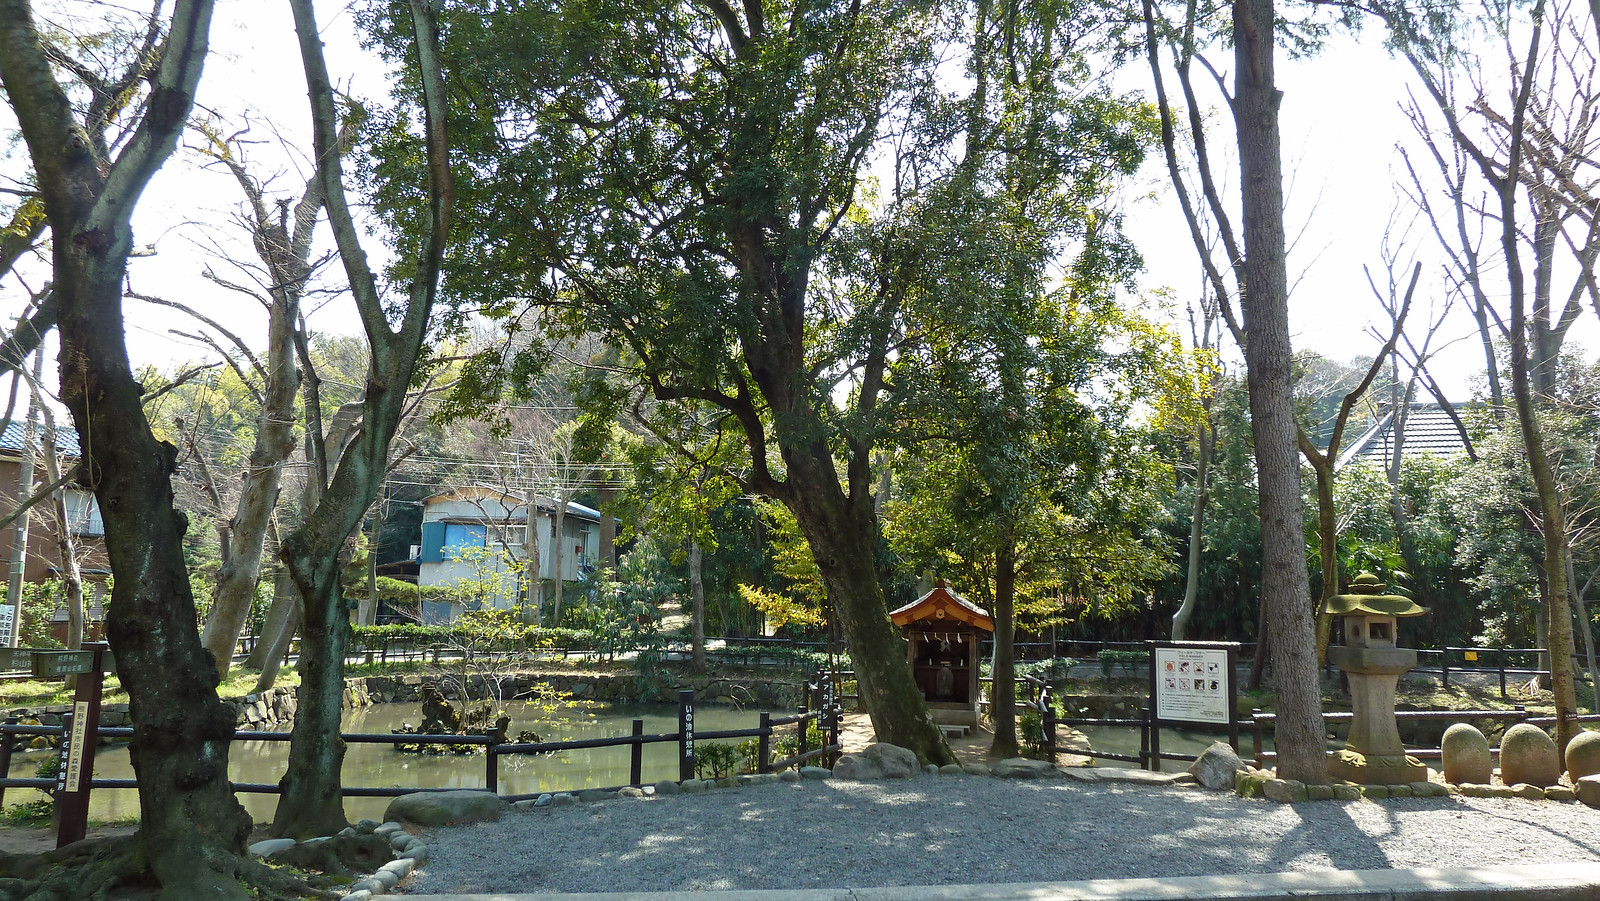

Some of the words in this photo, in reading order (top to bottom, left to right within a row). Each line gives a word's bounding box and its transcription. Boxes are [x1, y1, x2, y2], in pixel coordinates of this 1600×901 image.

[69, 705, 86, 788] 熊野神社市民の森愛護会
[685, 704, 693, 758] いの池休憩所
